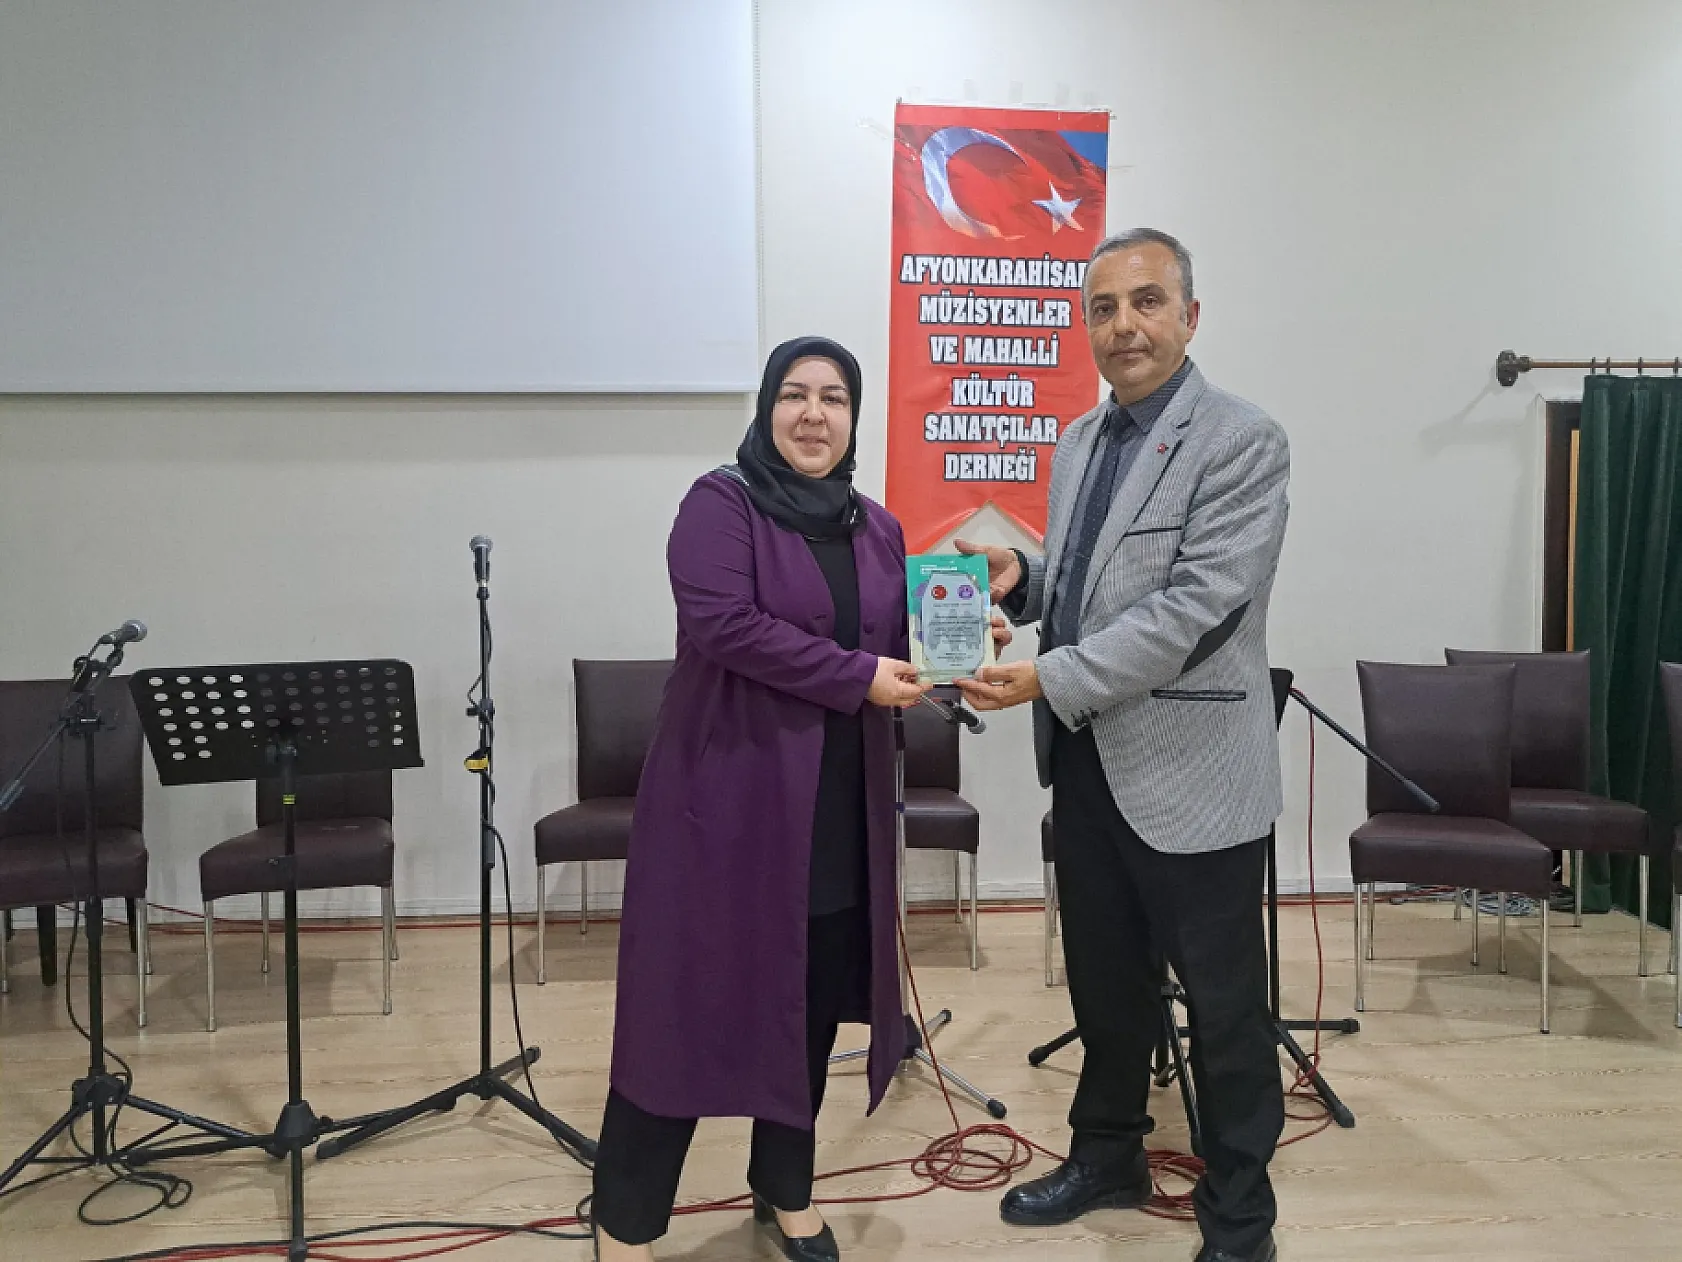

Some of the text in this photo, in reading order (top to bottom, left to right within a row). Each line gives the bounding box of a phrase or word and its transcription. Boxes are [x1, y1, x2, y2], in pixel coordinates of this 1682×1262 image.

[919, 289, 1072, 327] MÜZİSYENLER
[929, 332, 1059, 367] VE MAHALLİ
[951, 372, 1035, 407] KÜLTÜR
[924, 412, 1059, 448] SANATÇILAR
[944, 448, 1037, 482] DERNEĞİ
